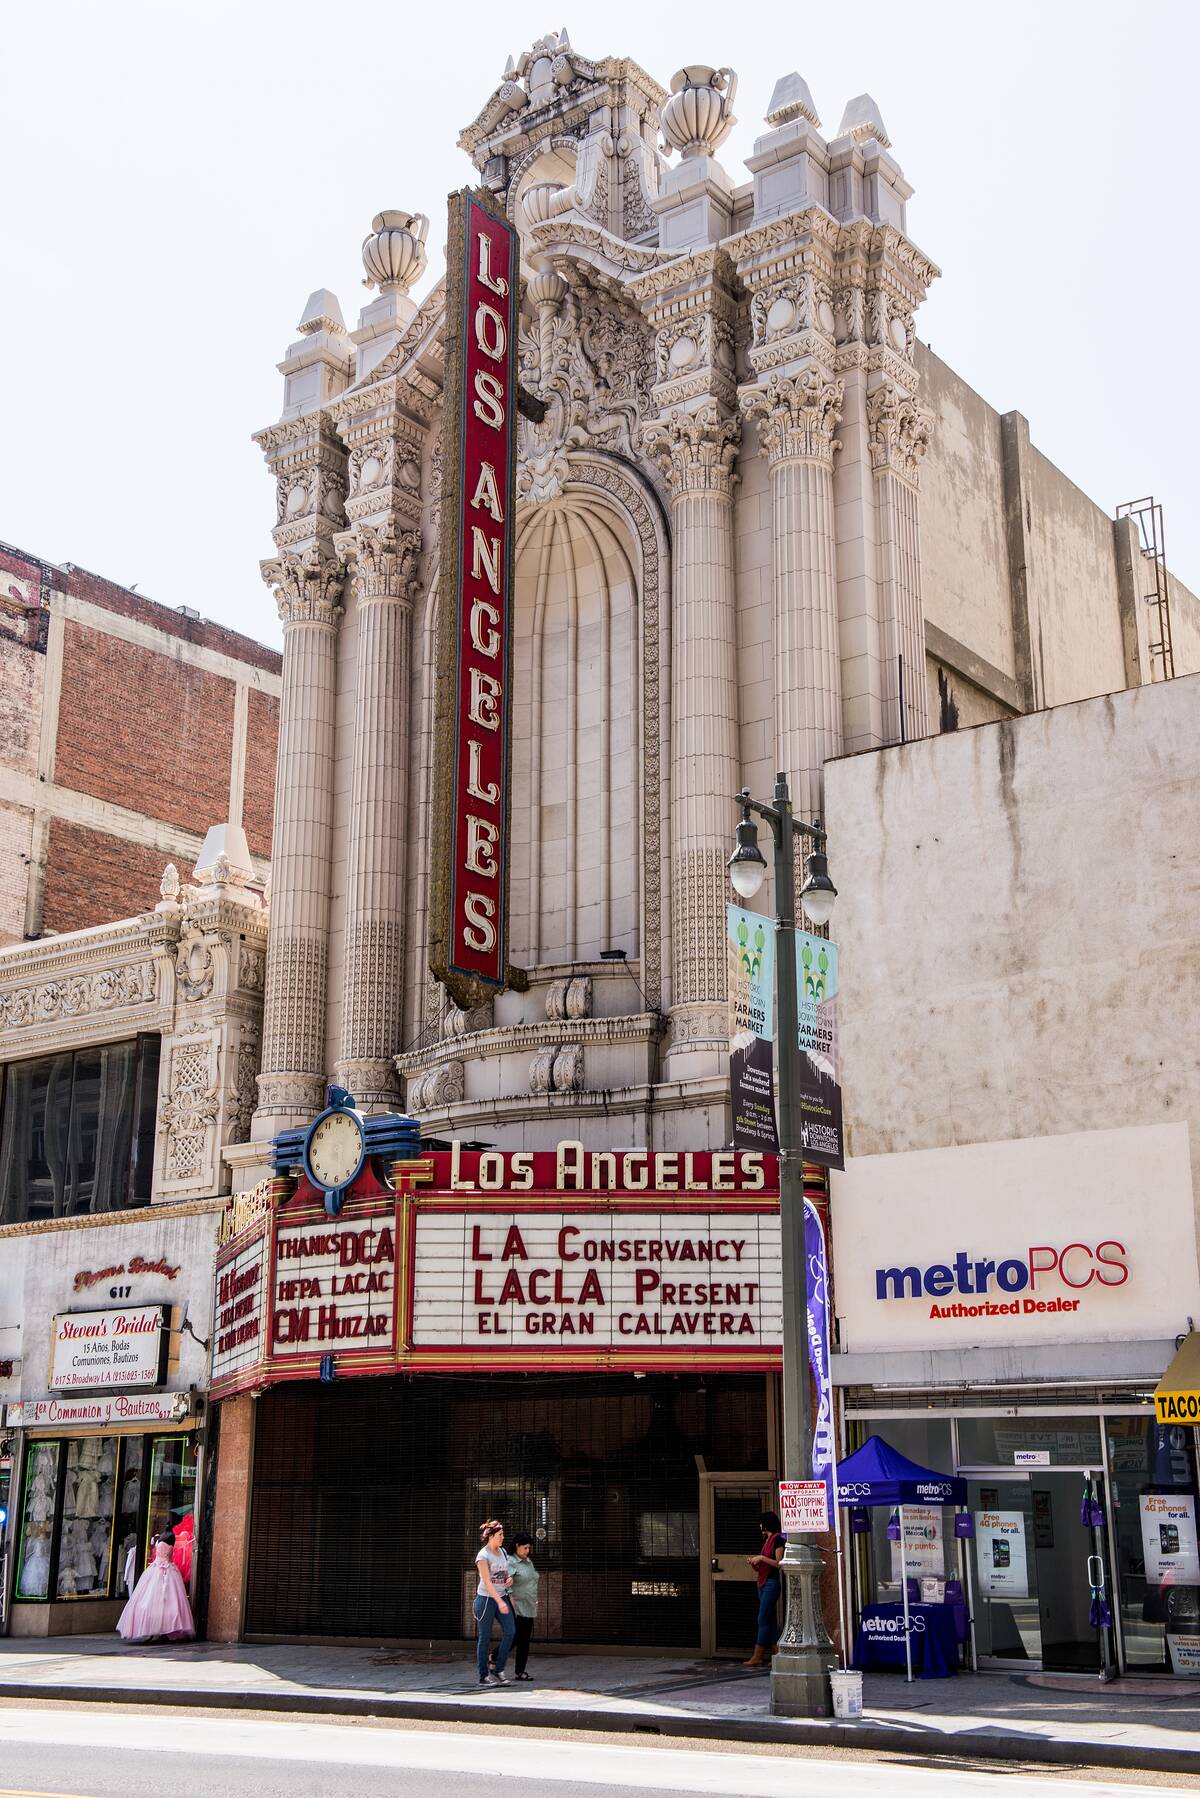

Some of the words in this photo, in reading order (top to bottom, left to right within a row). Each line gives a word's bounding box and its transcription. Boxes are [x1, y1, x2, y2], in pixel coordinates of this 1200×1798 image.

[473, 232, 509, 432] LOS
[463, 461, 505, 954] ANGELES
[734, 1001, 766, 1022] FARMERS
[736, 1016, 764, 1034] MARKET
[800, 1037, 831, 1053] MARKET
[348, 1119, 351, 1127] 1
[808, 1122, 838, 1138] HISTORIC
[316, 1132, 324, 1140] 10
[354, 1128, 359, 1136] 2
[356, 1142, 361, 1150] 3
[323, 1172, 328, 1180] 7
[345, 1169, 350, 1177] 5
[277, 1232, 341, 1260] THANKS
[339, 1227, 395, 1268] DCA
[471, 1225, 529, 1262] LA
[876, 1240, 1129, 1300] metroPCS
[109, 1286, 132, 1299] 617
[278, 1277, 322, 1301] HFPA
[331, 1270, 391, 1296] LACAC
[474, 1268, 605, 1305] LACLA
[929, 1299, 1020, 1319] Authorized
[1023, 1297, 1080, 1314] Dealer
[59, 1318, 107, 1340] Steven's
[112, 1313, 159, 1336] Bridal
[272, 1306, 310, 1344] CM
[478, 1312, 507, 1334] EL
[525, 1312, 594, 1334] GRAN
[618, 1312, 756, 1335] CALAVERA
[83, 1343, 91, 1354] 15
[91, 1341, 110, 1353] Años,
[111, 1339, 130, 1351] Bodas
[72, 1355, 111, 1367] Comuniones,
[113, 1352, 139, 1364] Bautizos
[55, 1375, 66, 1385] 617
[71, 1373, 100, 1384] Broadway
[48, 1399, 102, 1421] Communion
[105, 1404, 111, 1421] y
[115, 1396, 160, 1417] Bautizos
[159, 1410, 171, 1419] 617
[1158, 1396, 1200, 1419] TACO
[916, 1482, 952, 1496] metroPCS
[783, 1496, 796, 1508] NO
[797, 1497, 825, 1507] STOPPING
[1145, 1504, 1156, 1512] 4G
[1158, 1504, 1187, 1512] phones
[1148, 1497, 1167, 1505] Free
[785, 1509, 801, 1518] ANY
[805, 1508, 824, 1518] TIME
[983, 1513, 1000, 1521] Free
[1168, 1511, 1178, 1519] for
[1178, 1511, 1190, 1519] all.
[980, 1520, 991, 1528] 4G
[991, 1520, 1018, 1529] phones
[914, 1541, 938, 1551] punto.
